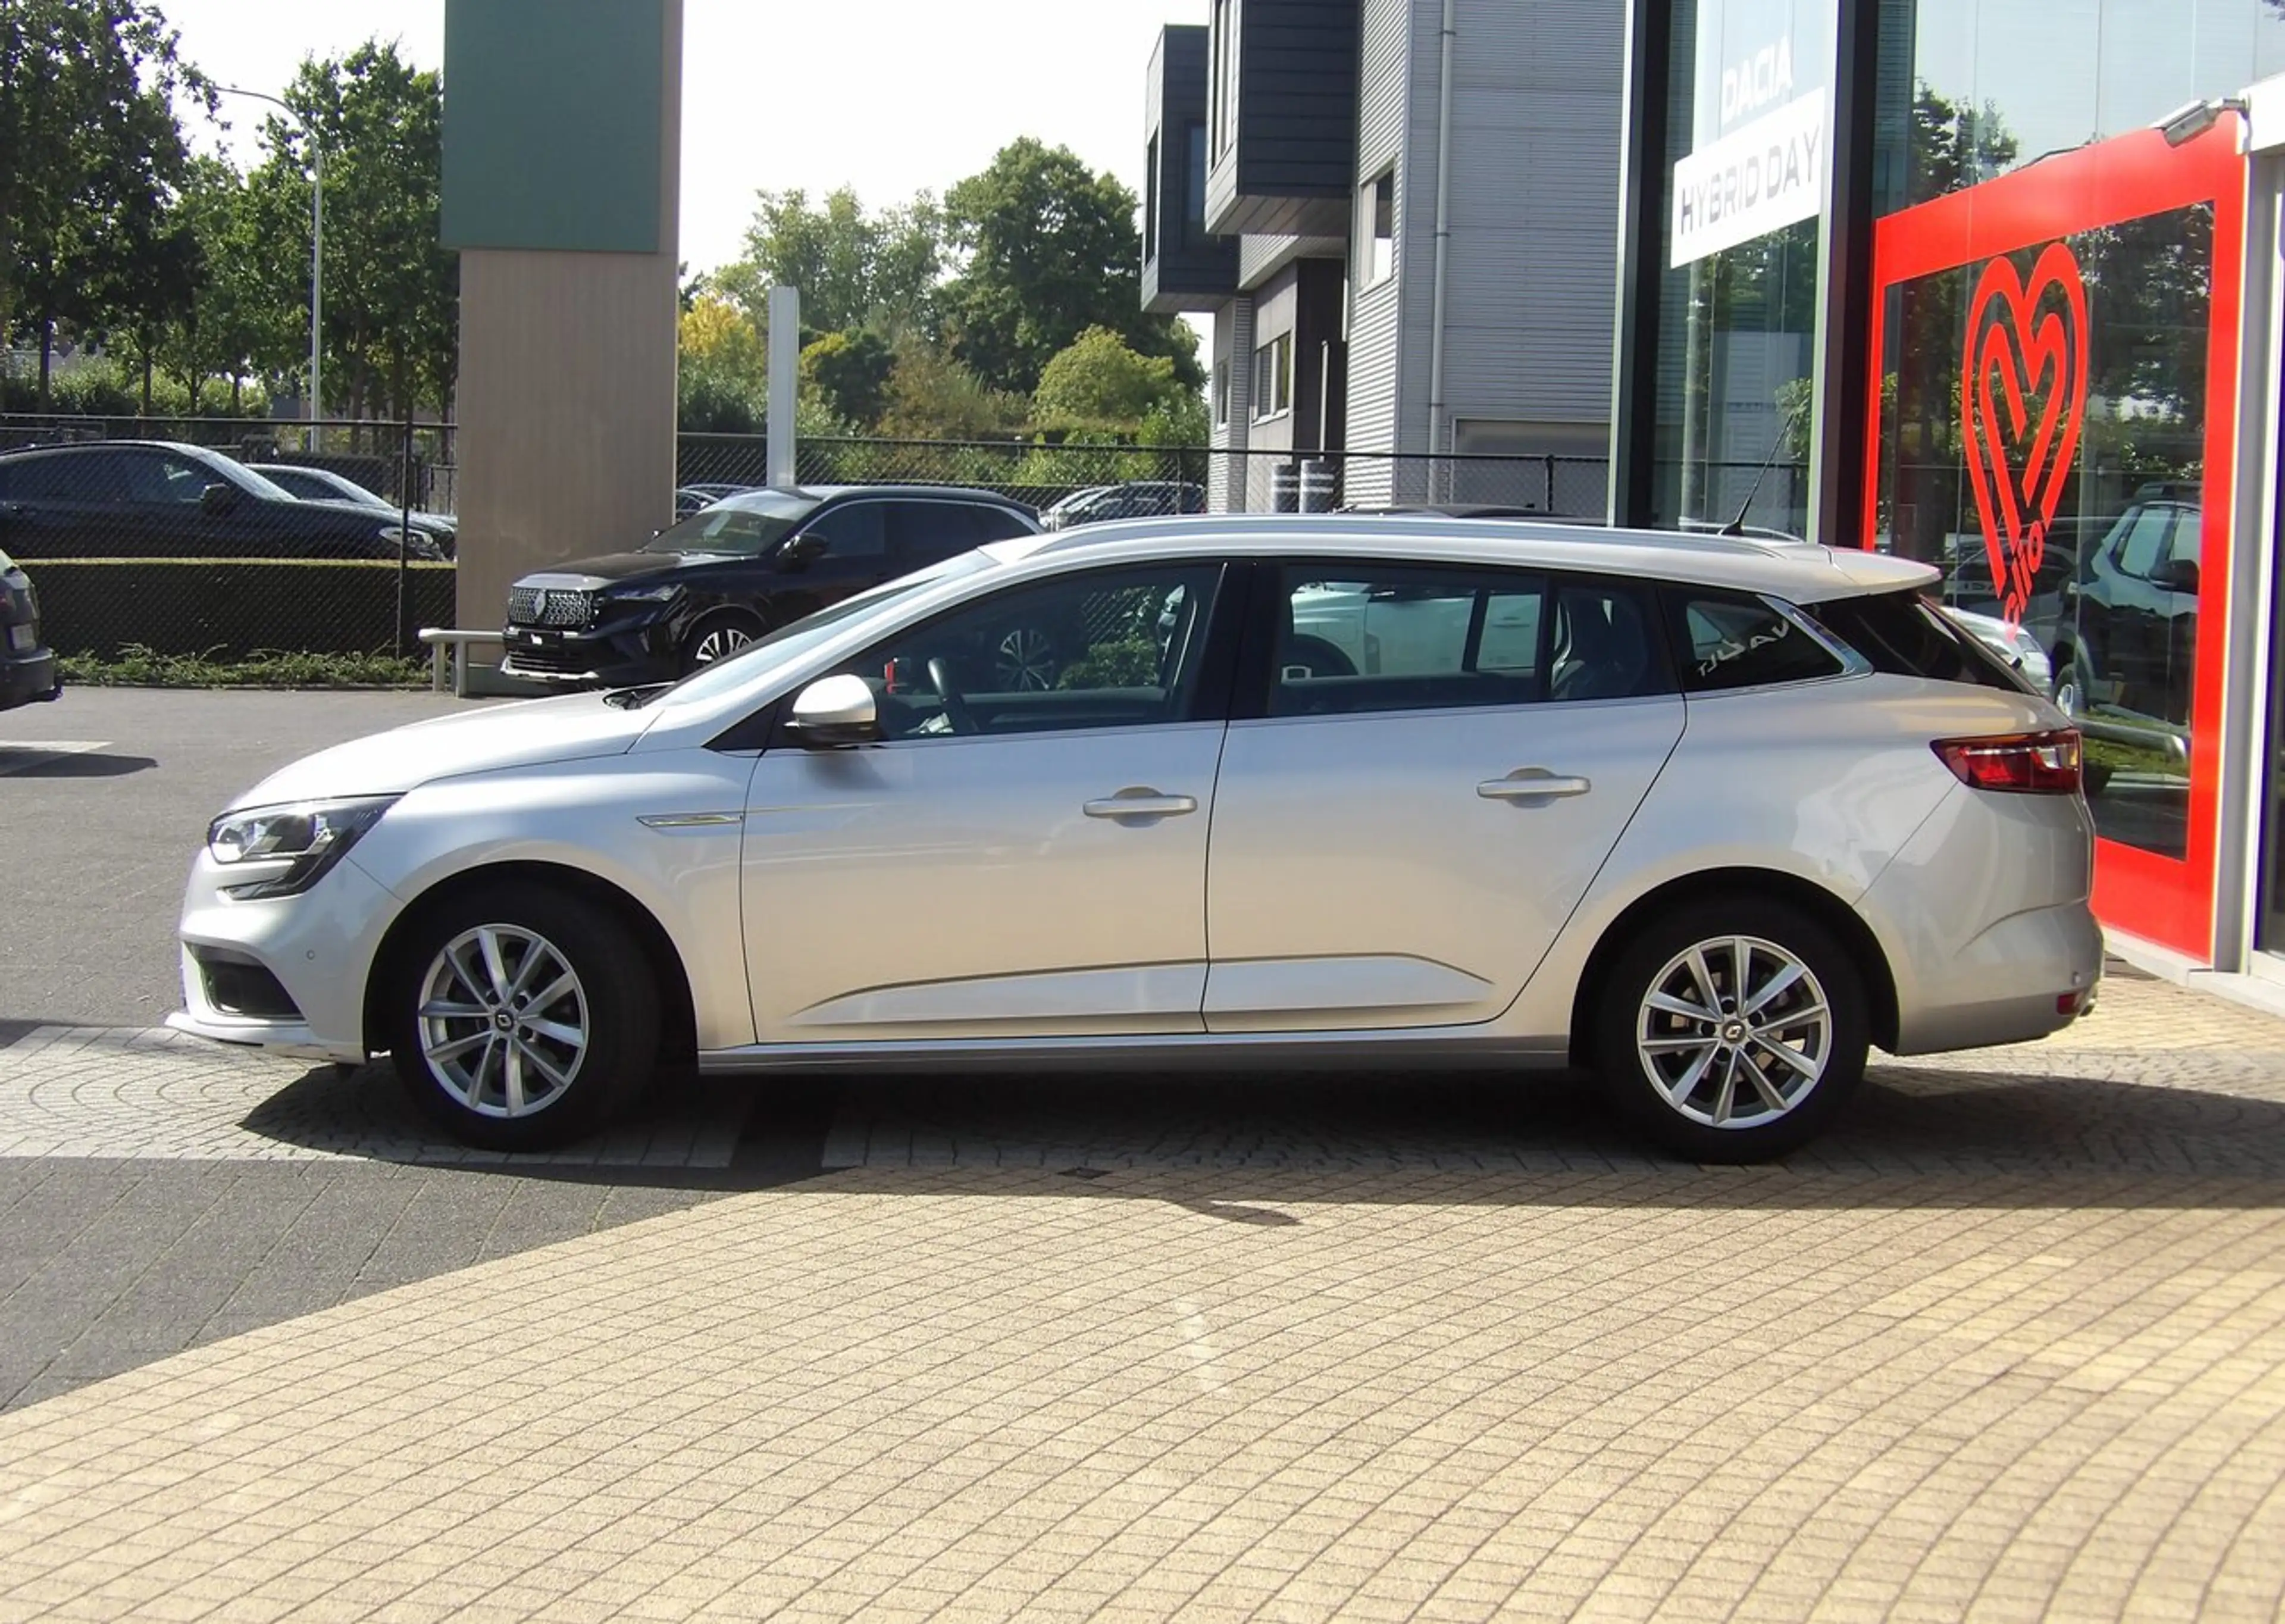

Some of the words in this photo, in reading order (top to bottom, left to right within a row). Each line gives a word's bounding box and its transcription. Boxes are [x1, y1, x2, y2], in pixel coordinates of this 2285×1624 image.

[1723, 36, 1793, 126] DACIA
[1681, 156, 1760, 235] HYBRID
[1767, 123, 1820, 200] DAY
